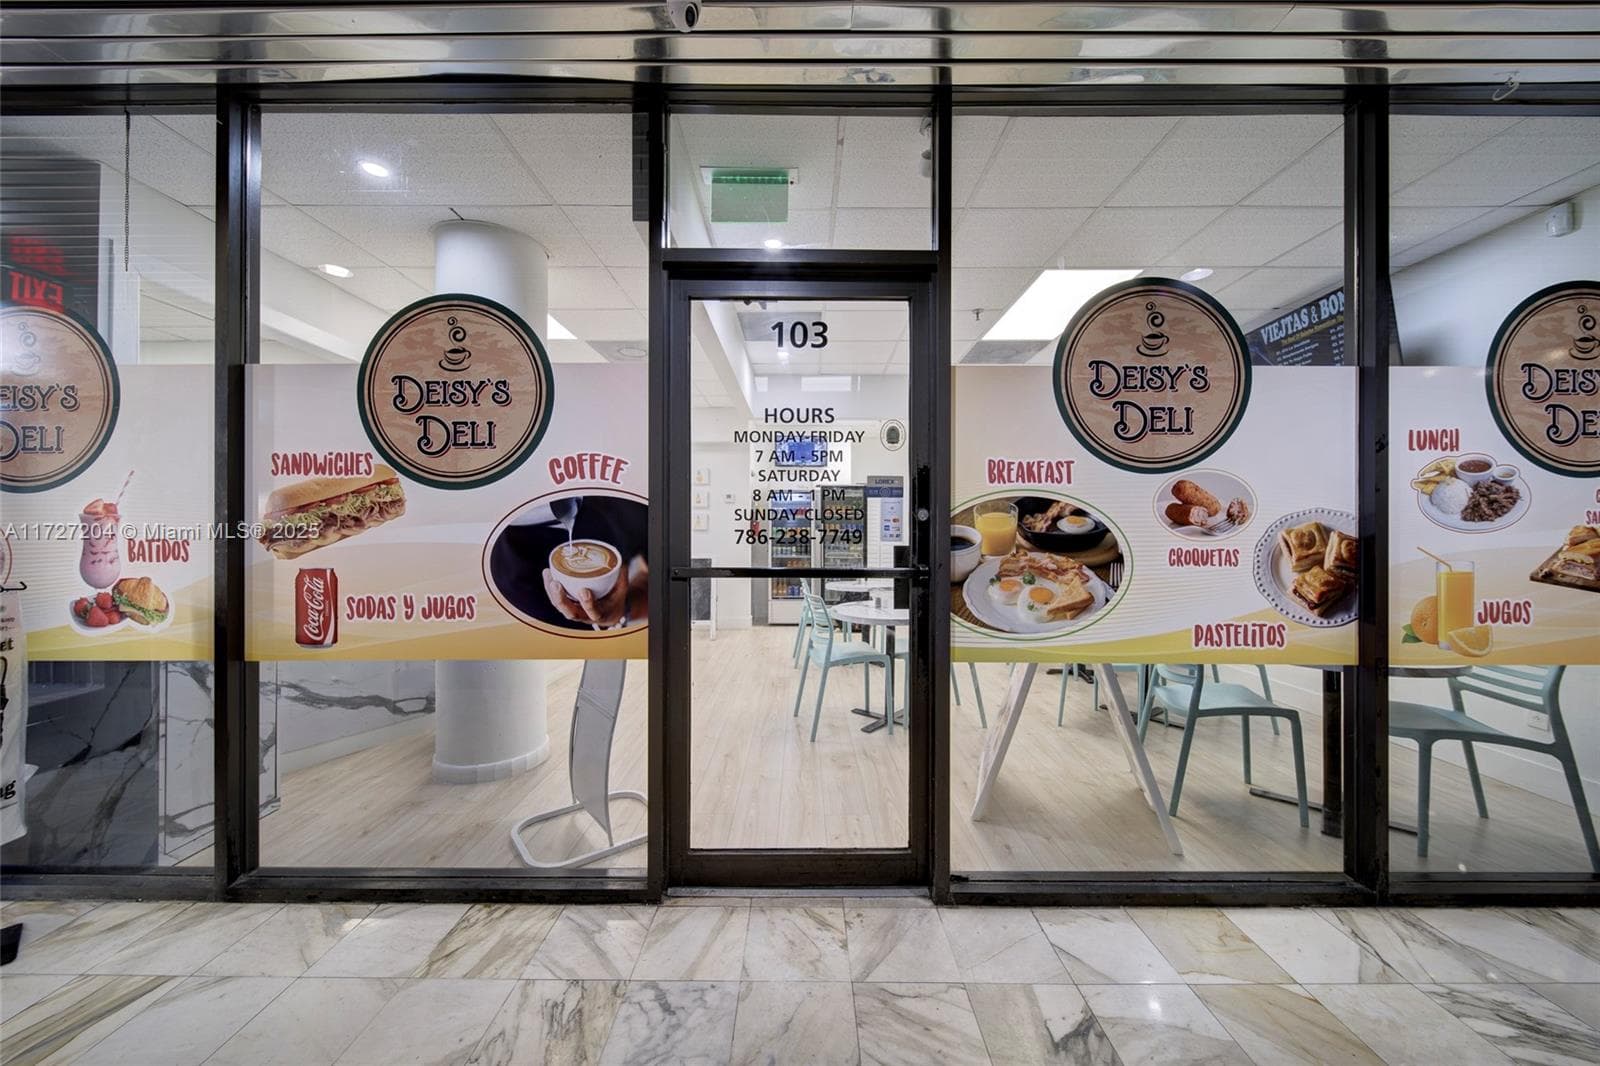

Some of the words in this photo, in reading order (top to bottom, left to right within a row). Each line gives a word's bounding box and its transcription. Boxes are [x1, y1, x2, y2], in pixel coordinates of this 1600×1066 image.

[1310, 305, 1319, 324] &
[771, 321, 829, 349] 103
[1088, 360, 1212, 399] DEISY'S
[1521, 363, 1600, 403] DEIS
[391, 375, 512, 415] DEISY'S
[765, 408, 835, 424] HOURS
[1112, 400, 1195, 443] DELI
[1545, 403, 1600, 447] DE
[415, 415, 498, 458] DELI
[1408, 428, 1459, 451] LUNCH
[755, 450, 761, 462] 7
[769, 450, 795, 462] AM
[549, 453, 629, 485] COFFEE
[758, 469, 840, 482] SATURDAY
[987, 459, 1075, 485] BREAKFAST
[753, 489, 761, 501] 8
[767, 489, 793, 501] AM
[810, 489, 816, 501] 1
[823, 489, 845, 501] PM
[734, 508, 796, 521] SUNDAY
[804, 508, 864, 521] CLOSED
[734, 529, 863, 545] 786-238-7749
[1168, 547, 1239, 567] CROQUETAS
[346, 596, 396, 620] SODAS
[403, 595, 414, 620] Y
[421, 595, 476, 620] JUGOS
[1478, 600, 1531, 624] JUGOS
